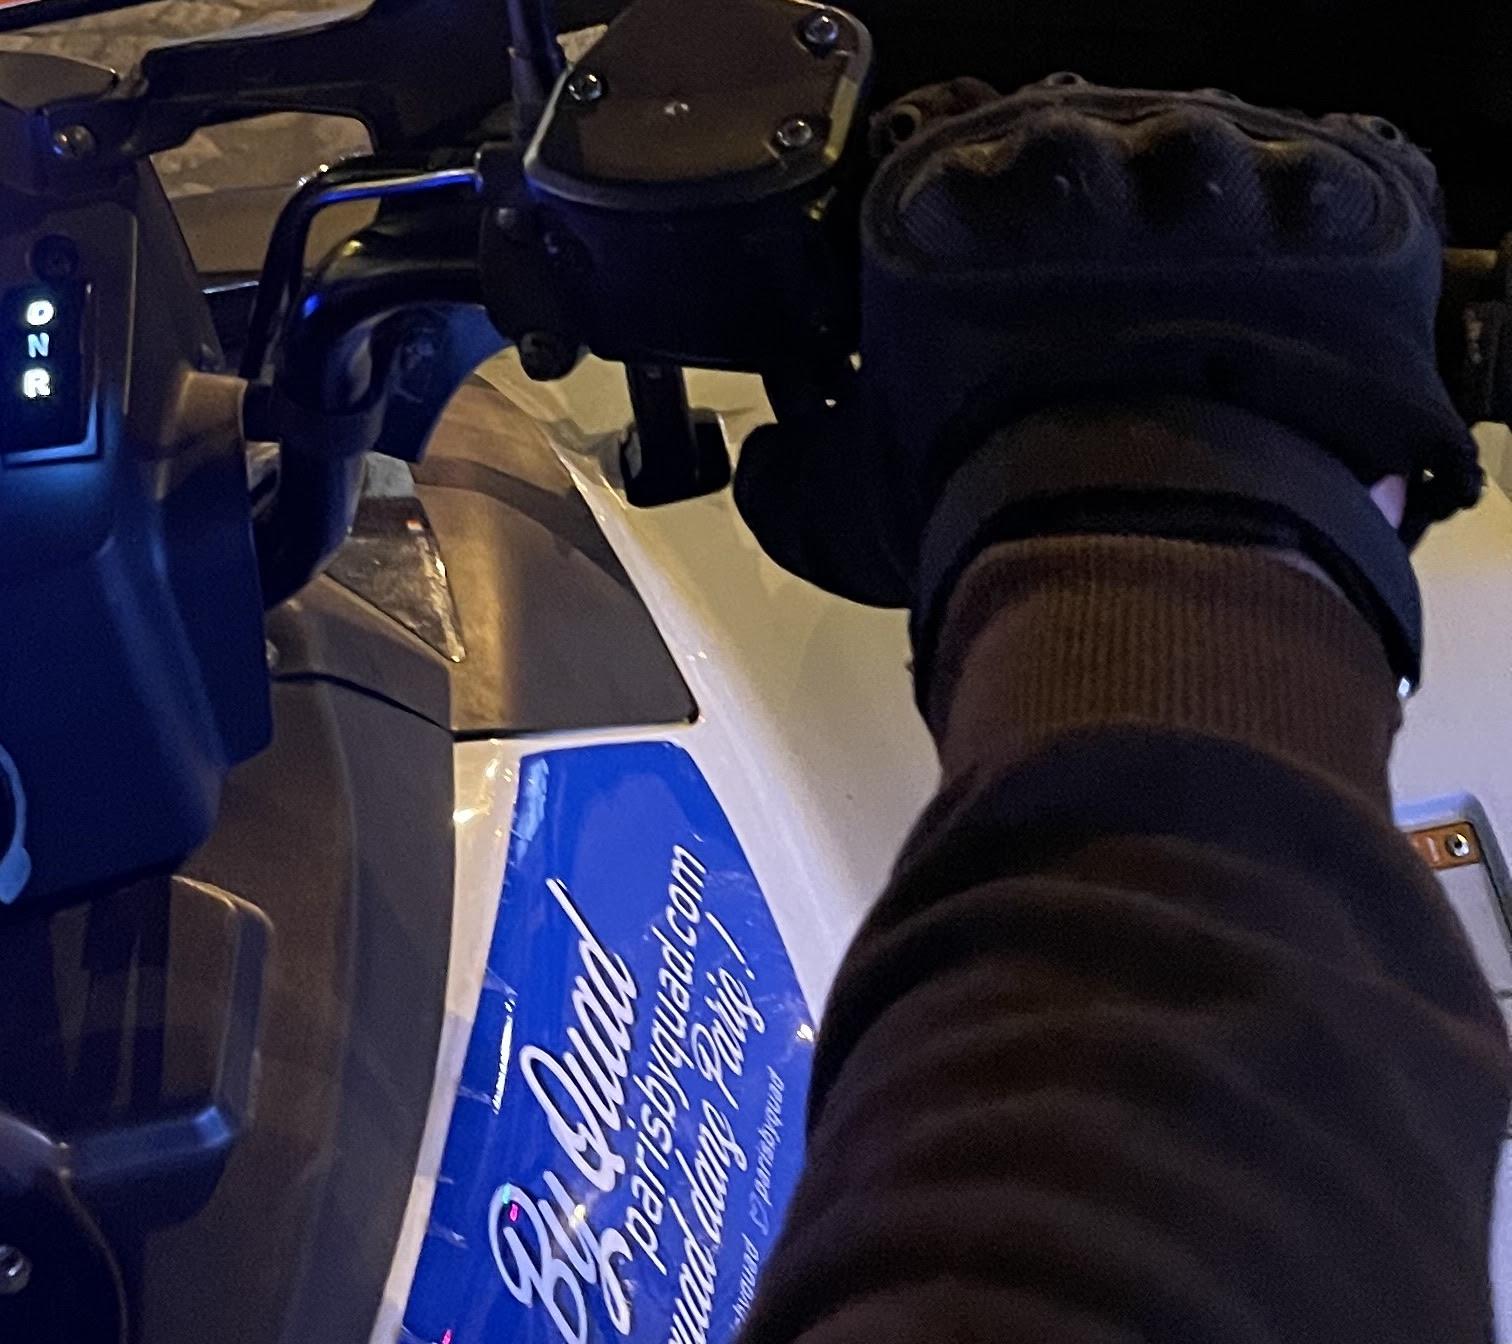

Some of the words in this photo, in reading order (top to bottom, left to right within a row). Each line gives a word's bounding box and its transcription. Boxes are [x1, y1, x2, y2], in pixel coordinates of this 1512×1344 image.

[23, 368, 51, 398] R
[28, 332, 49, 358] N
[519, 877, 638, 1192] Quad
[624, 844, 707, 1276] parisbyquad.com
[753, 1064, 786, 1208] parisbyquad
[667, 1196, 718, 1344] uad
